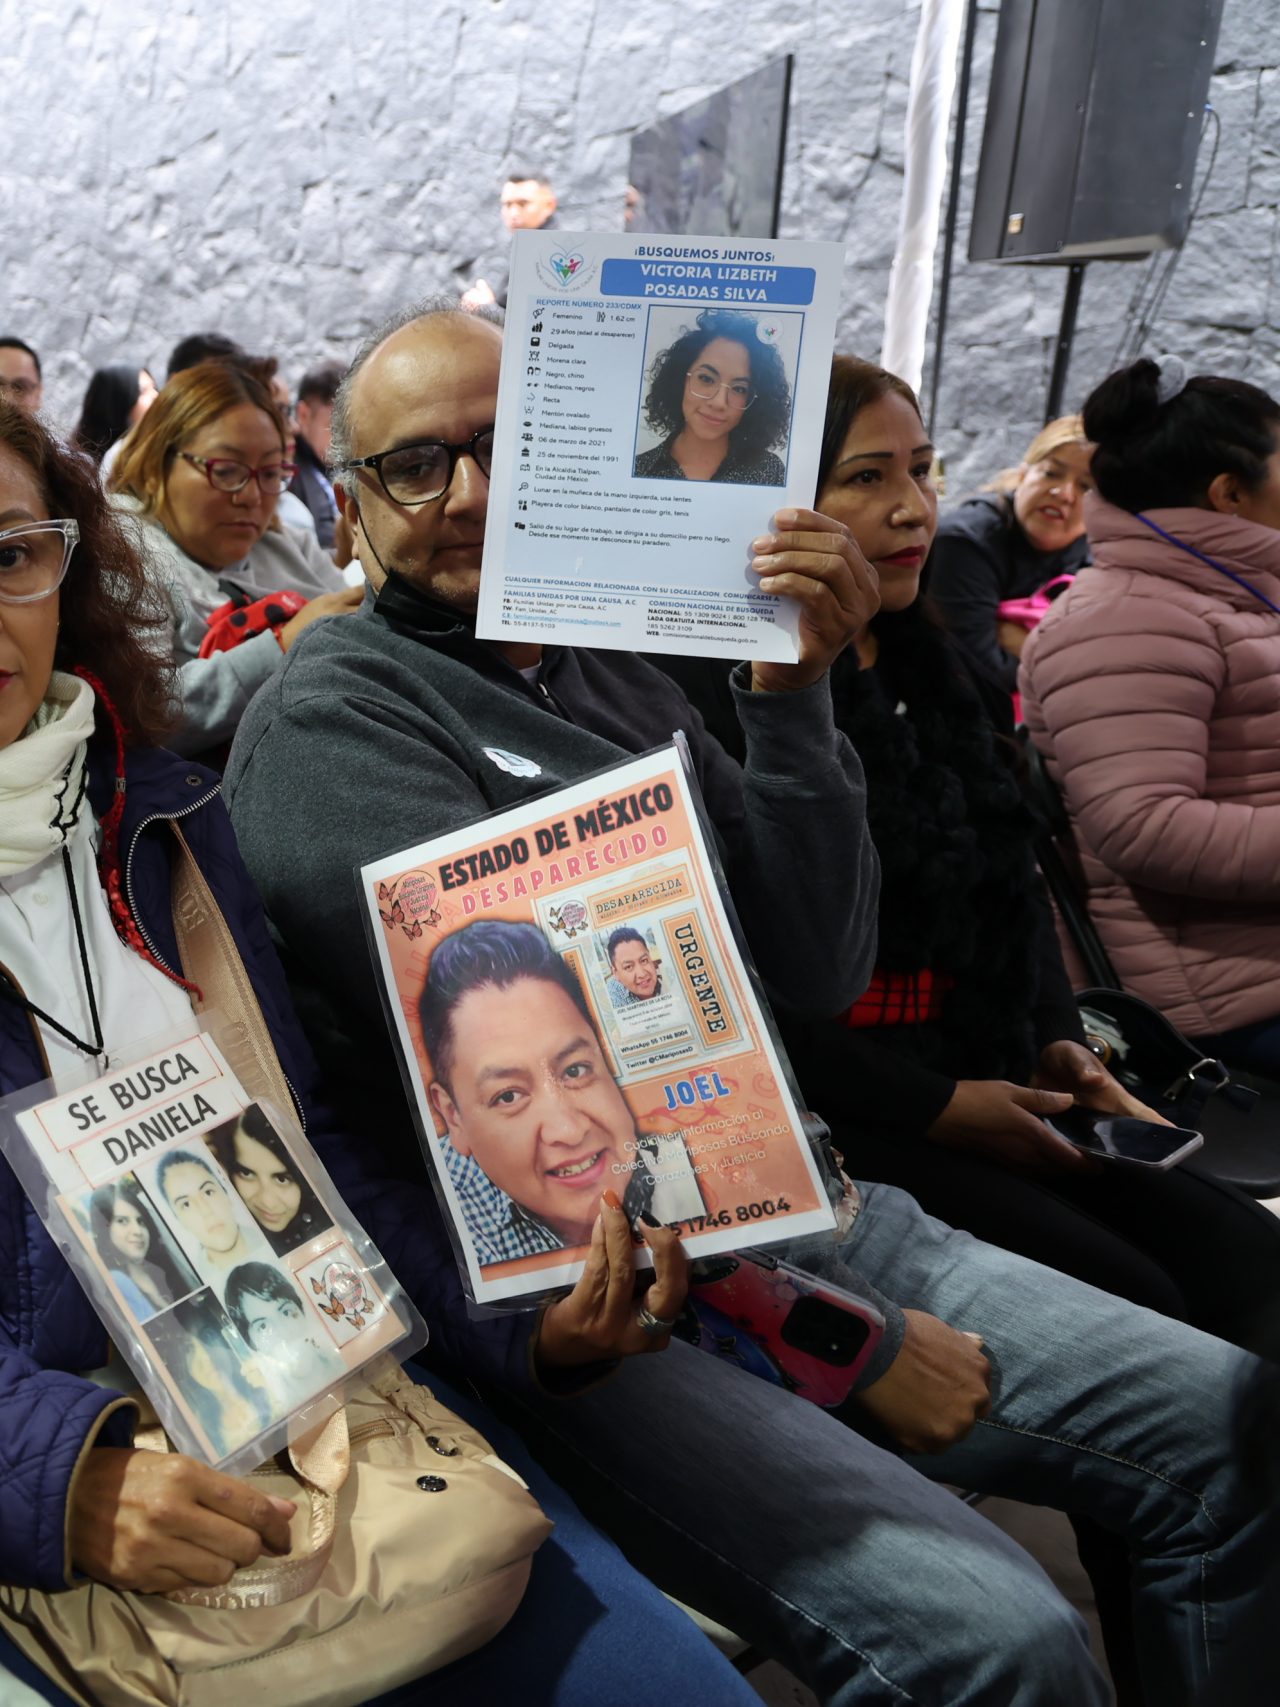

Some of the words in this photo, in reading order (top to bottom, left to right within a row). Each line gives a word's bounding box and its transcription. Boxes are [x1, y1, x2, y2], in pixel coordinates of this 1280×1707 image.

[641, 264, 712, 279] VICTORIA
[717, 268, 777, 282] LIZBETH
[645, 283, 719, 299] POSADAS
[724, 287, 767, 301] SILVA
[536, 299, 570, 307] REPORTE
[548, 342, 574, 350] Delgada
[531, 500, 553, 508] Playera
[600, 536, 632, 544] desconoce
[504, 576, 541, 584] CUALQUIER
[593, 583, 640, 591] RELACIONADA
[723, 592, 772, 601] COMUNICARSE
[504, 590, 536, 598] FAMILIAS
[687, 603, 724, 611] NACIONAL
[438, 837, 529, 892] ESTADO
[535, 821, 571, 856] DE
[573, 783, 674, 842] MÉXICO
[462, 825, 668, 915] DESAPARECIDO
[596, 878, 682, 914] DESAPARECIDA
[675, 923, 727, 1033] URGENTE
[621, 1041, 650, 1053] WhatsApp
[626, 1060, 647, 1069] Twitter
[68, 1095, 107, 1131] SE
[109, 1053, 199, 1110] BUSCA
[664, 1072, 730, 1109] JOEL
[752, 1109, 764, 1120] al
[102, 1093, 218, 1166] DANIELA
[611, 1154, 664, 1175] Colectivo
[728, 1124, 790, 1145] Buscando
[710, 1161, 718, 1172] y
[720, 1150, 766, 1167] Justicia
[687, 1209, 731, 1233] 1746
[736, 1197, 791, 1222] 8004
